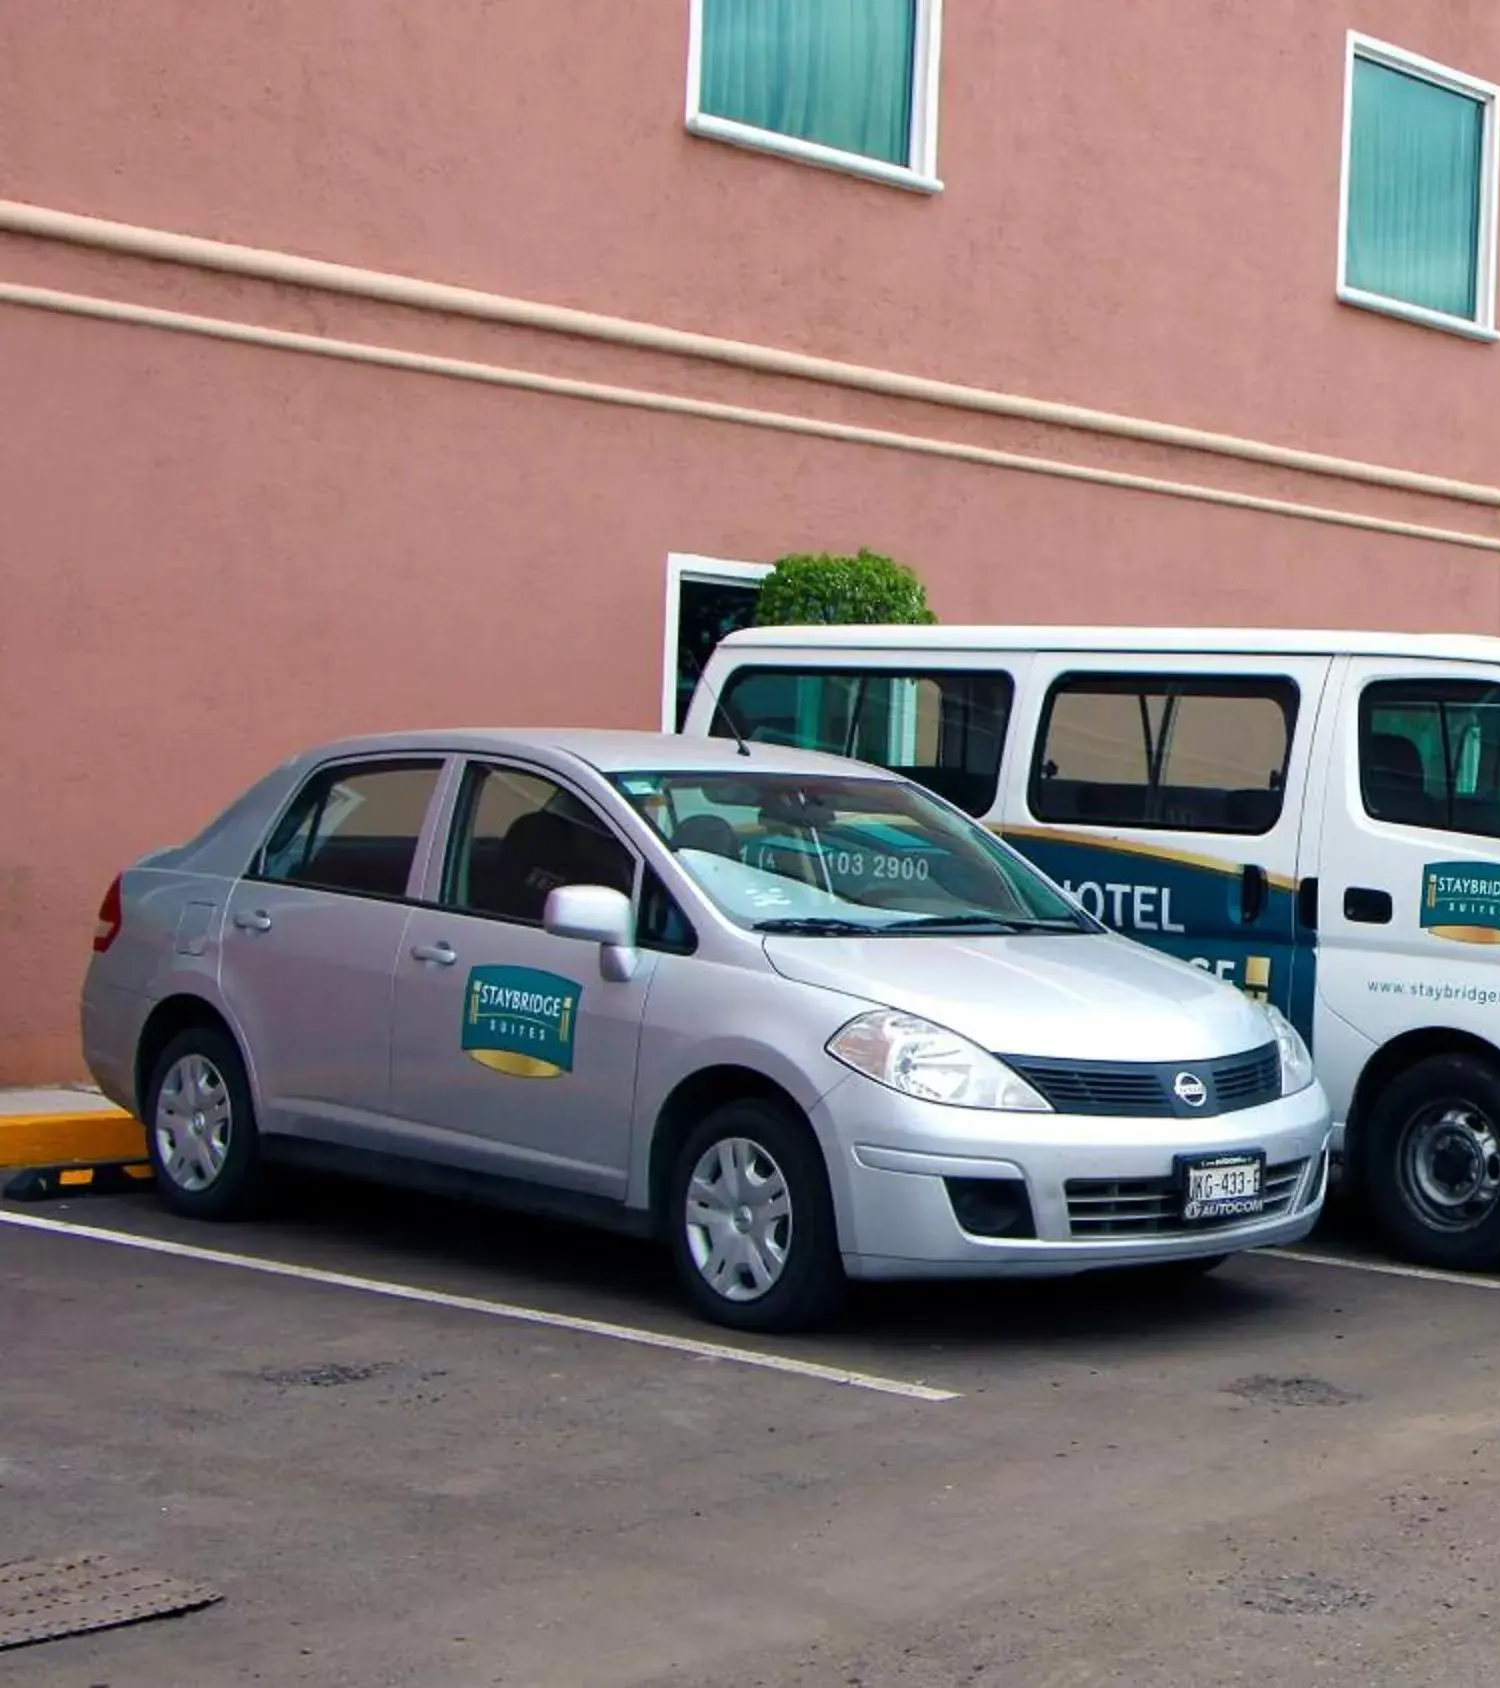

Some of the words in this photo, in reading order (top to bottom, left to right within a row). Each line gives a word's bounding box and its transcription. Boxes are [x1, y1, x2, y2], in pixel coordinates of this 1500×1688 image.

[873, 856, 929, 881] 2900
[1061, 879, 1186, 933] OTEL
[480, 984, 561, 1017] STAYBRIDGE
[489, 1019, 546, 1041] SUITES
